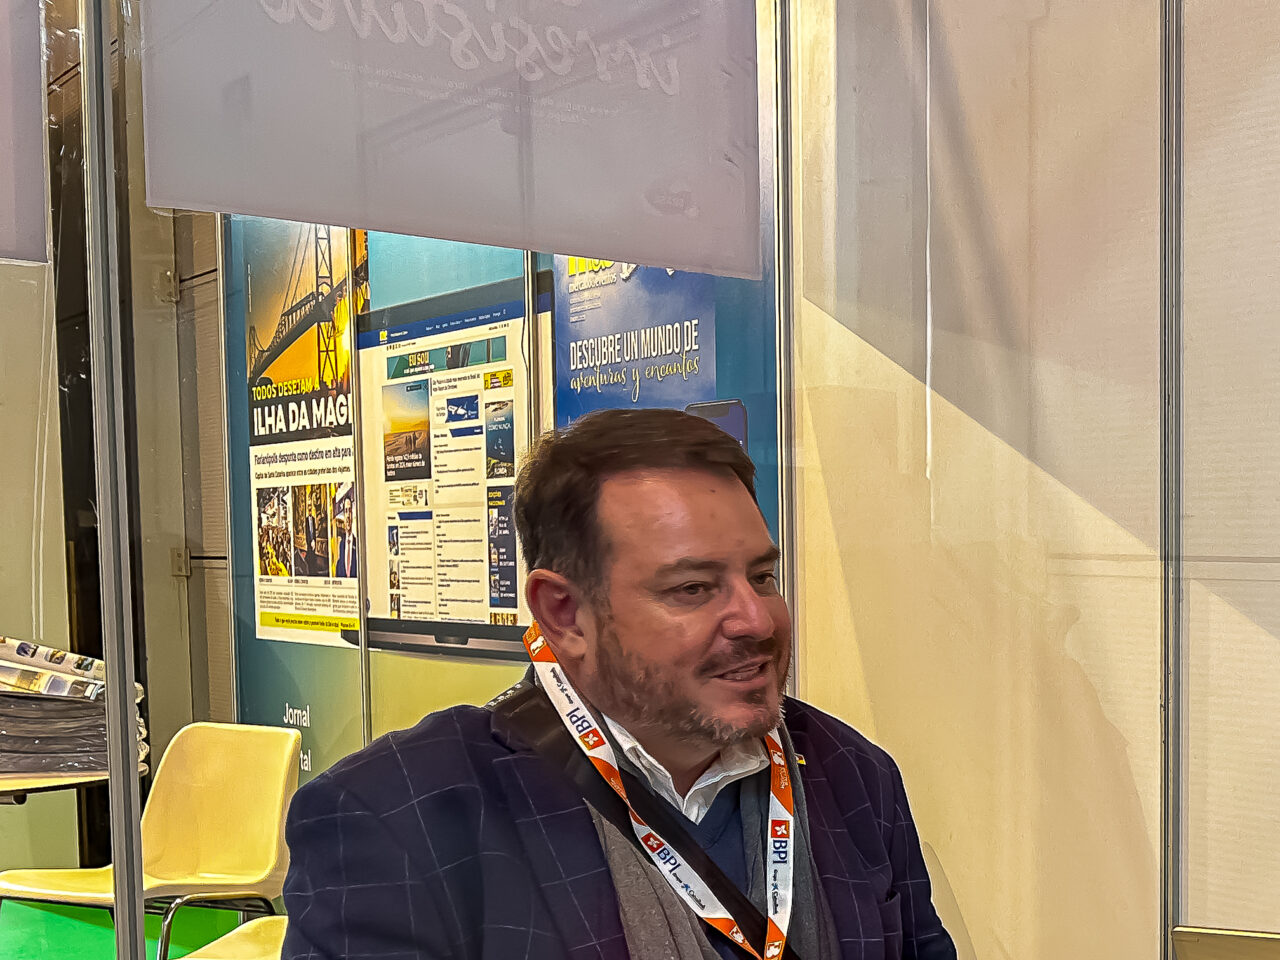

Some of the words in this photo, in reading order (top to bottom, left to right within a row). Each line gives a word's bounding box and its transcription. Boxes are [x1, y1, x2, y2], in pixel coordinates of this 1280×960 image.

[569, 334, 622, 371] DESCUBRE
[623, 330, 638, 362] UN
[640, 322, 680, 359] MUNDO
[683, 318, 699, 351] DE
[252, 383, 278, 401] TODOS
[278, 377, 313, 397] DESEJAM
[570, 362, 627, 394] aventuras
[631, 370, 641, 402] y
[645, 353, 700, 381] encantos
[253, 404, 287, 436] ILHA
[288, 400, 311, 432] DA
[282, 702, 311, 728] Jornal
[566, 707, 593, 734] BPI
[656, 847, 681, 874] BPI
[772, 839, 788, 864] BPI
